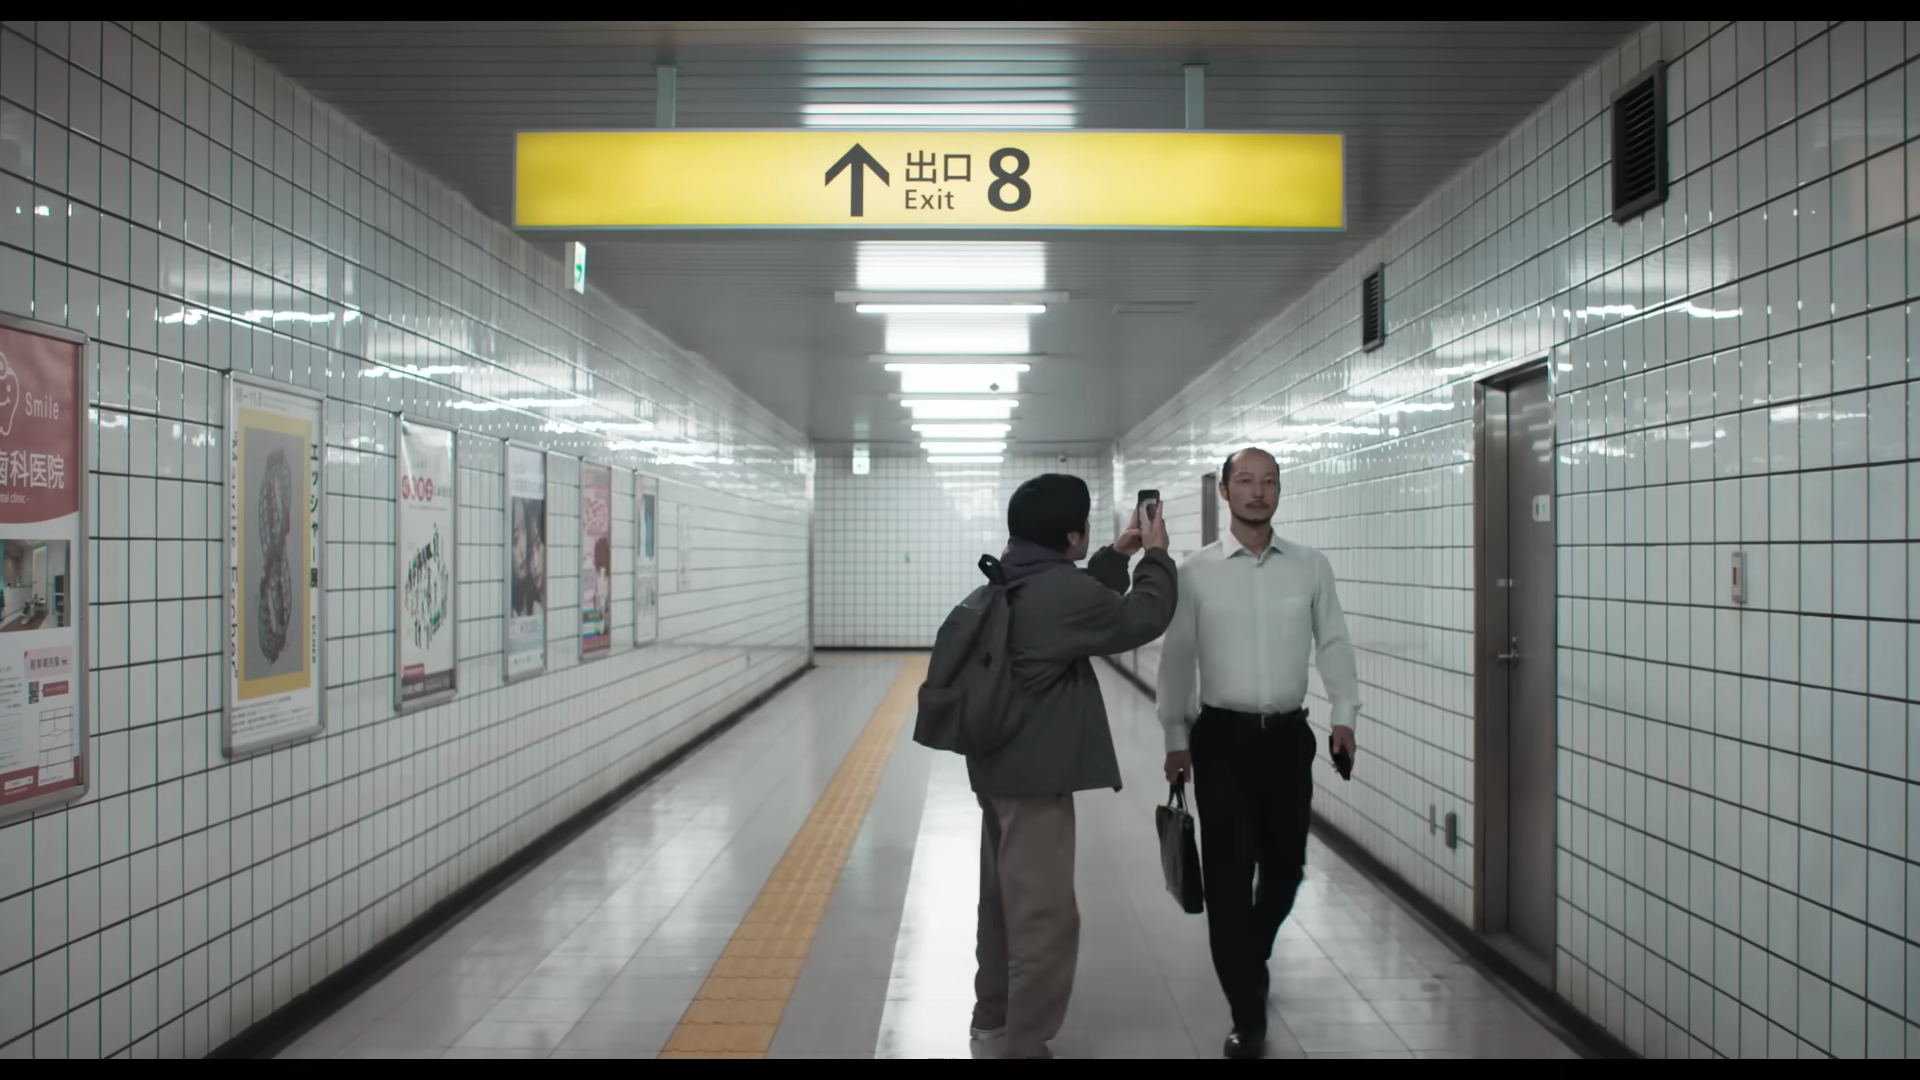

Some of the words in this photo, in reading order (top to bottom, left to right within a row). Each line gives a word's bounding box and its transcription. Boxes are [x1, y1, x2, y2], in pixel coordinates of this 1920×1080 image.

[905, 150, 971, 184] 出口
[987, 147, 1032, 212] 8
[905, 188, 955, 210] Exit
[25, 391, 60, 420] Smile
